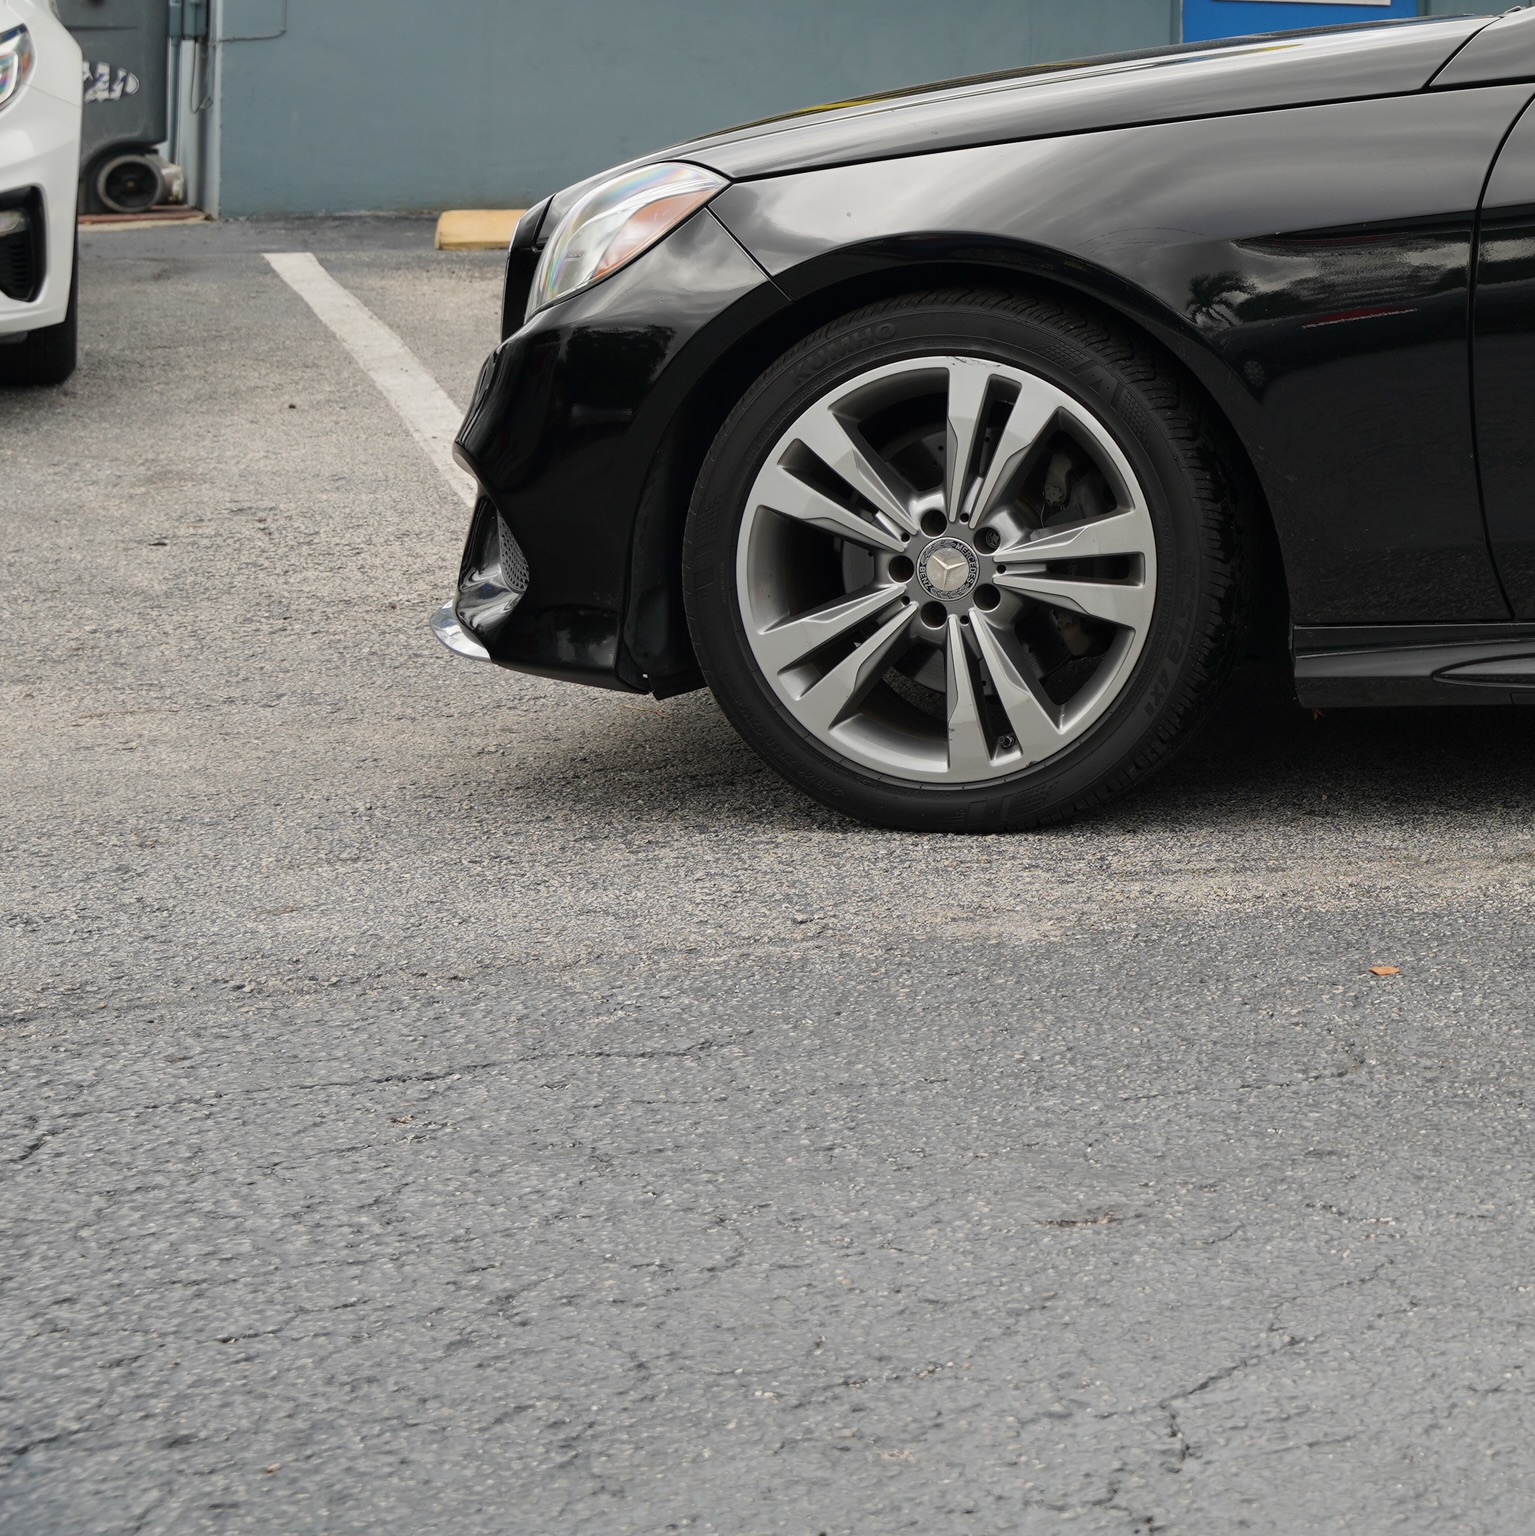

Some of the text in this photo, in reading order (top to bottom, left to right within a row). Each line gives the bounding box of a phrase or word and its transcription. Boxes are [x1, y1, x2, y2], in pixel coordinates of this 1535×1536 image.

[785, 320, 899, 385] KUMHO
[920, 566, 934, 589] BENZ
[955, 543, 976, 584] MERCEDES
